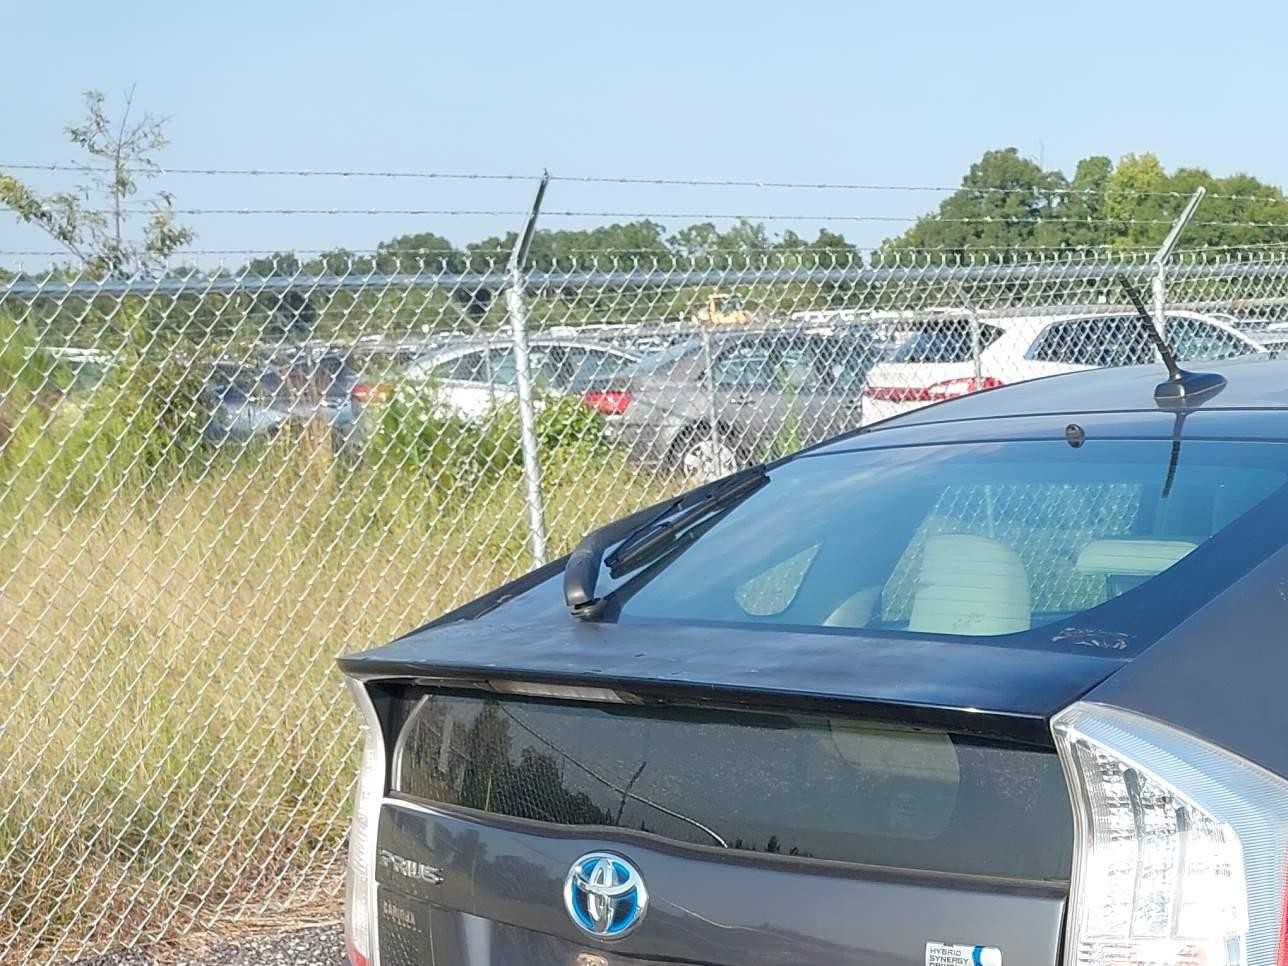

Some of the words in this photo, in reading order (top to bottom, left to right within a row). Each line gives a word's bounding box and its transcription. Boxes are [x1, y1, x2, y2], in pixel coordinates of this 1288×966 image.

[380, 849, 444, 885] PRIUS
[929, 947, 962, 957] HYBRID
[929, 954, 969, 965] SYNERGY
